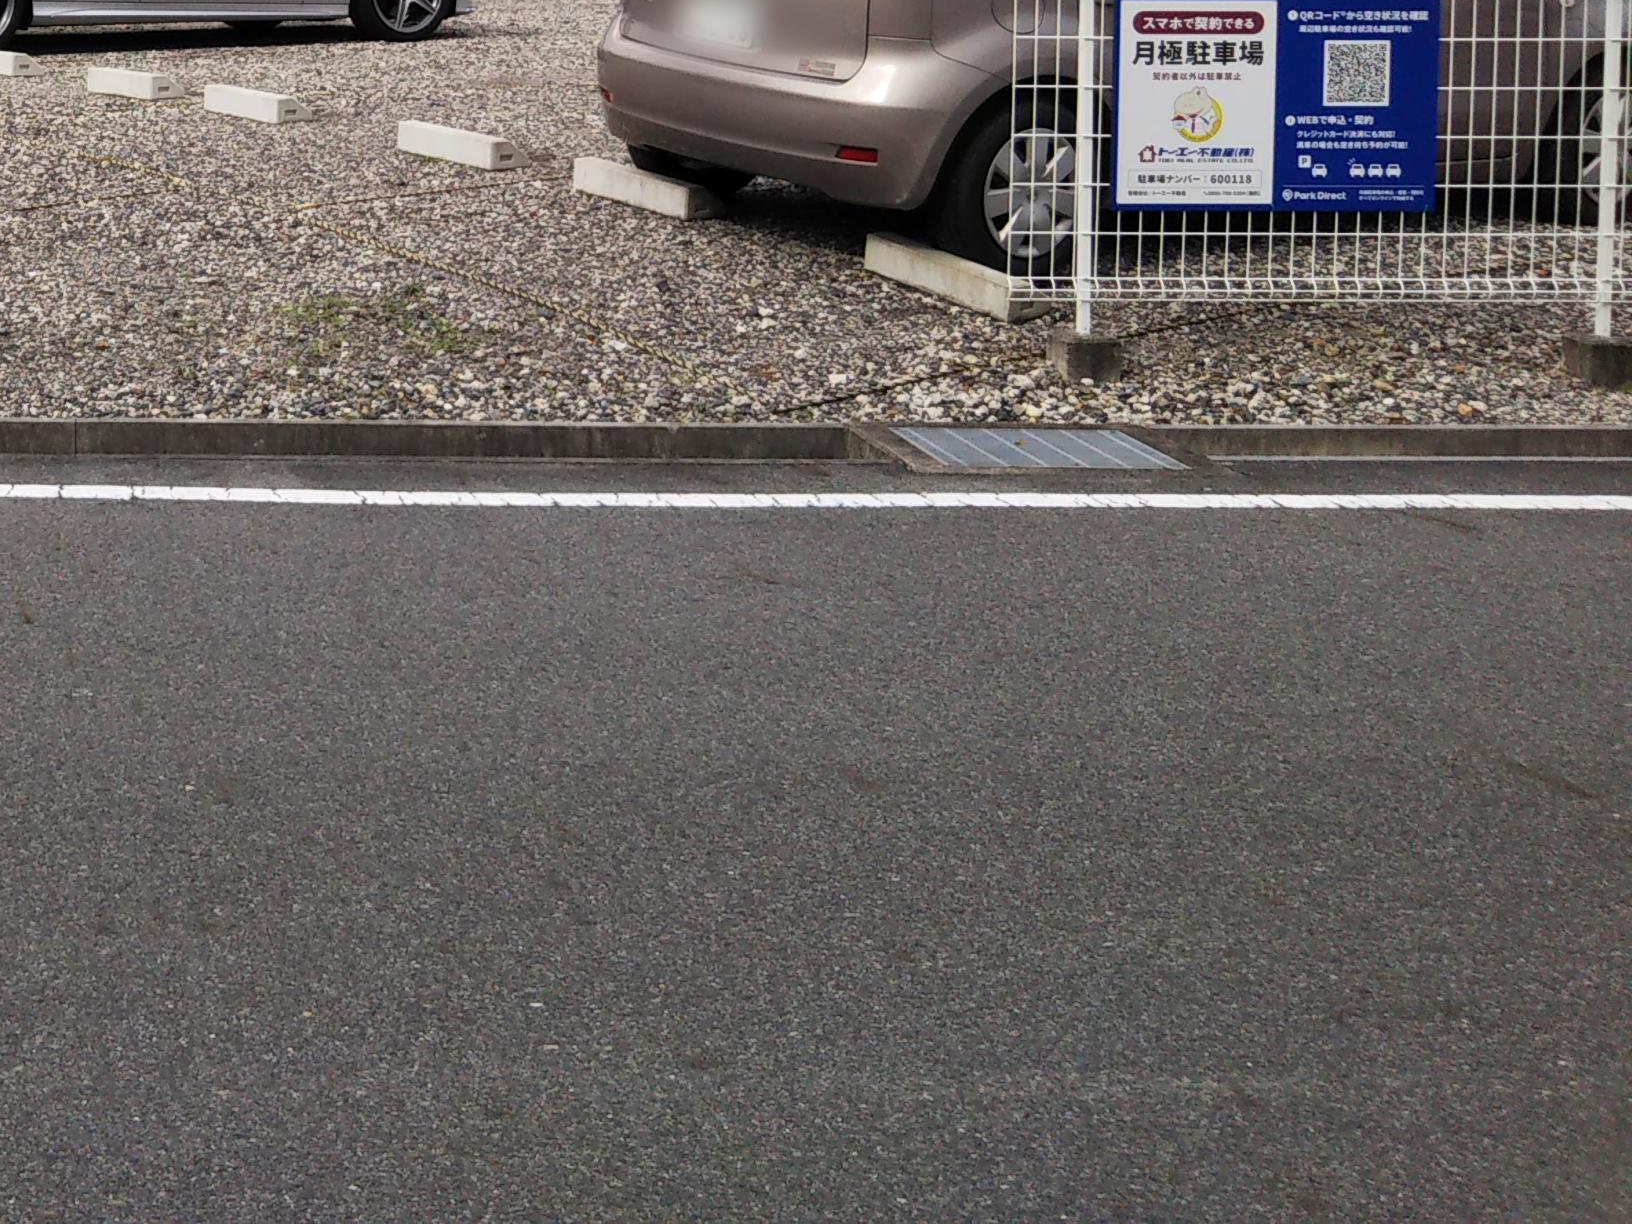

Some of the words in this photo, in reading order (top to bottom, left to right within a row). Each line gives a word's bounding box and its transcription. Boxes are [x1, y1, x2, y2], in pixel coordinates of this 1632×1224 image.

[1142, 16, 1255, 30] スマホで契約できる
[1132, 40, 1265, 65] 月極駐車場
[1152, 72, 1242, 80] 契約者以外は駐車禁止
[1294, 191, 1315, 200] Park
[1317, 191, 1347, 200] Direct
